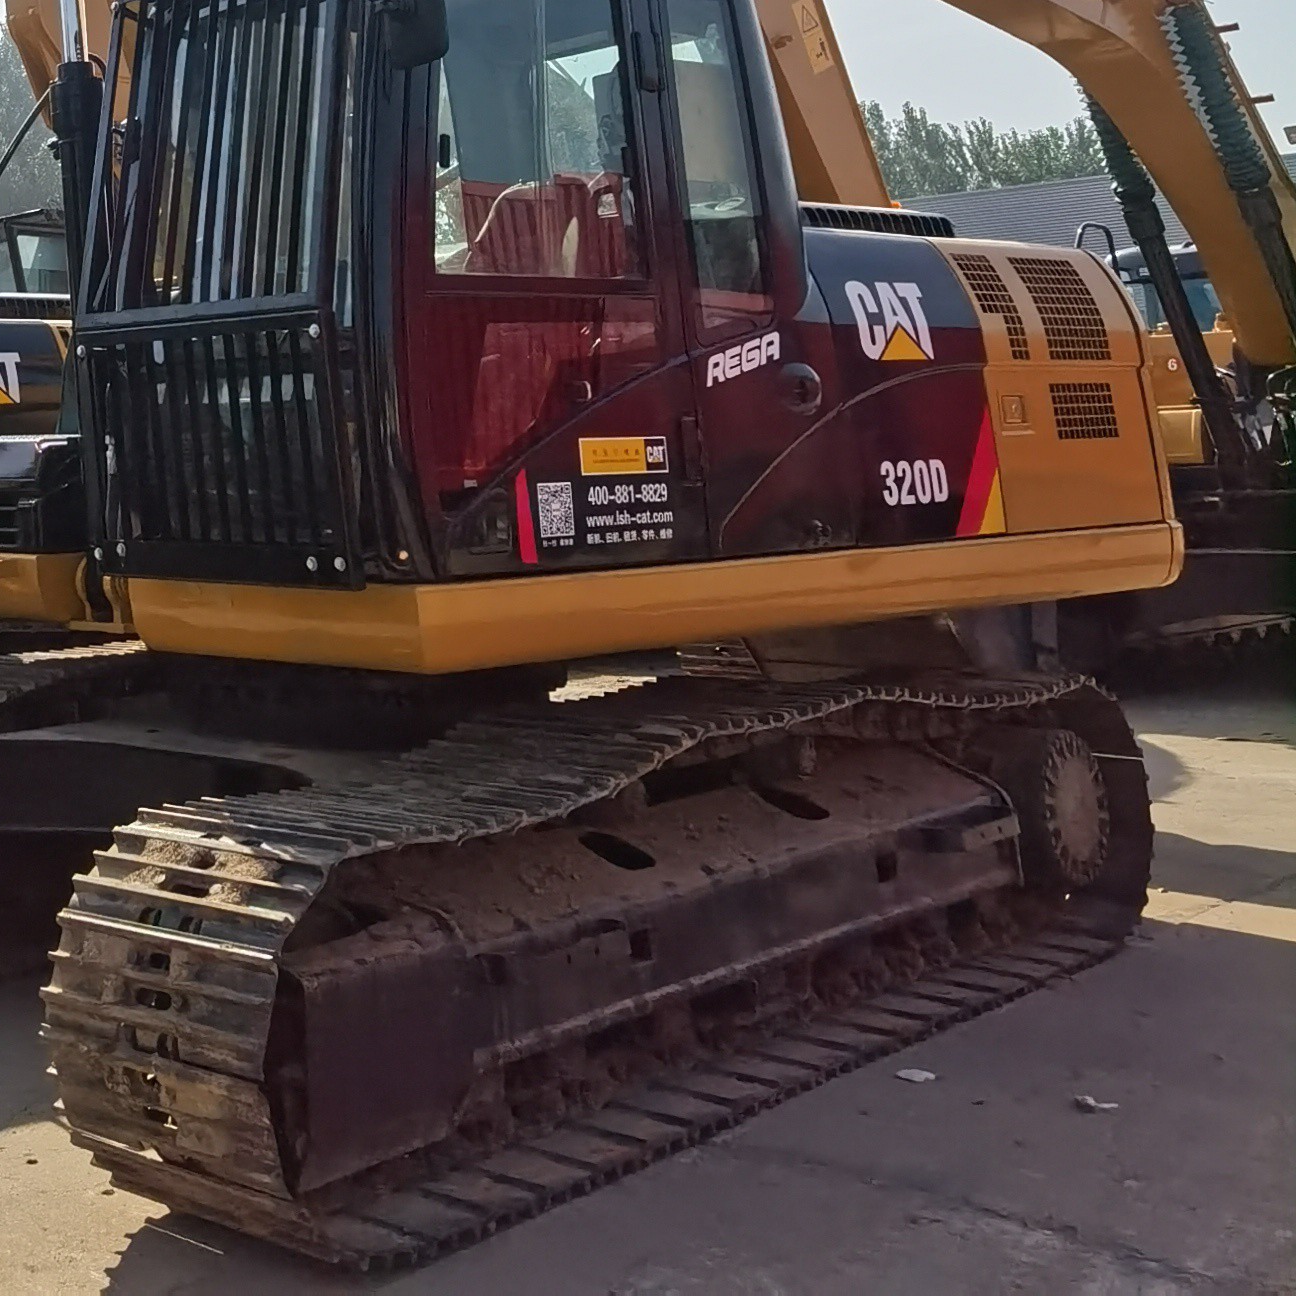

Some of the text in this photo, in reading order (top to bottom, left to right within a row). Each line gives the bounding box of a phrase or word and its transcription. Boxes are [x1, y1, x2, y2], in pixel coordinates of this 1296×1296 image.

[845, 280, 934, 361] CAT
[706, 331, 781, 388] REGA
[646, 445, 664, 462] CAT
[588, 483, 668, 505] 400-881-8829
[880, 459, 949, 506] 320D
[586, 510, 673, 527] www.lsh-cat.com
